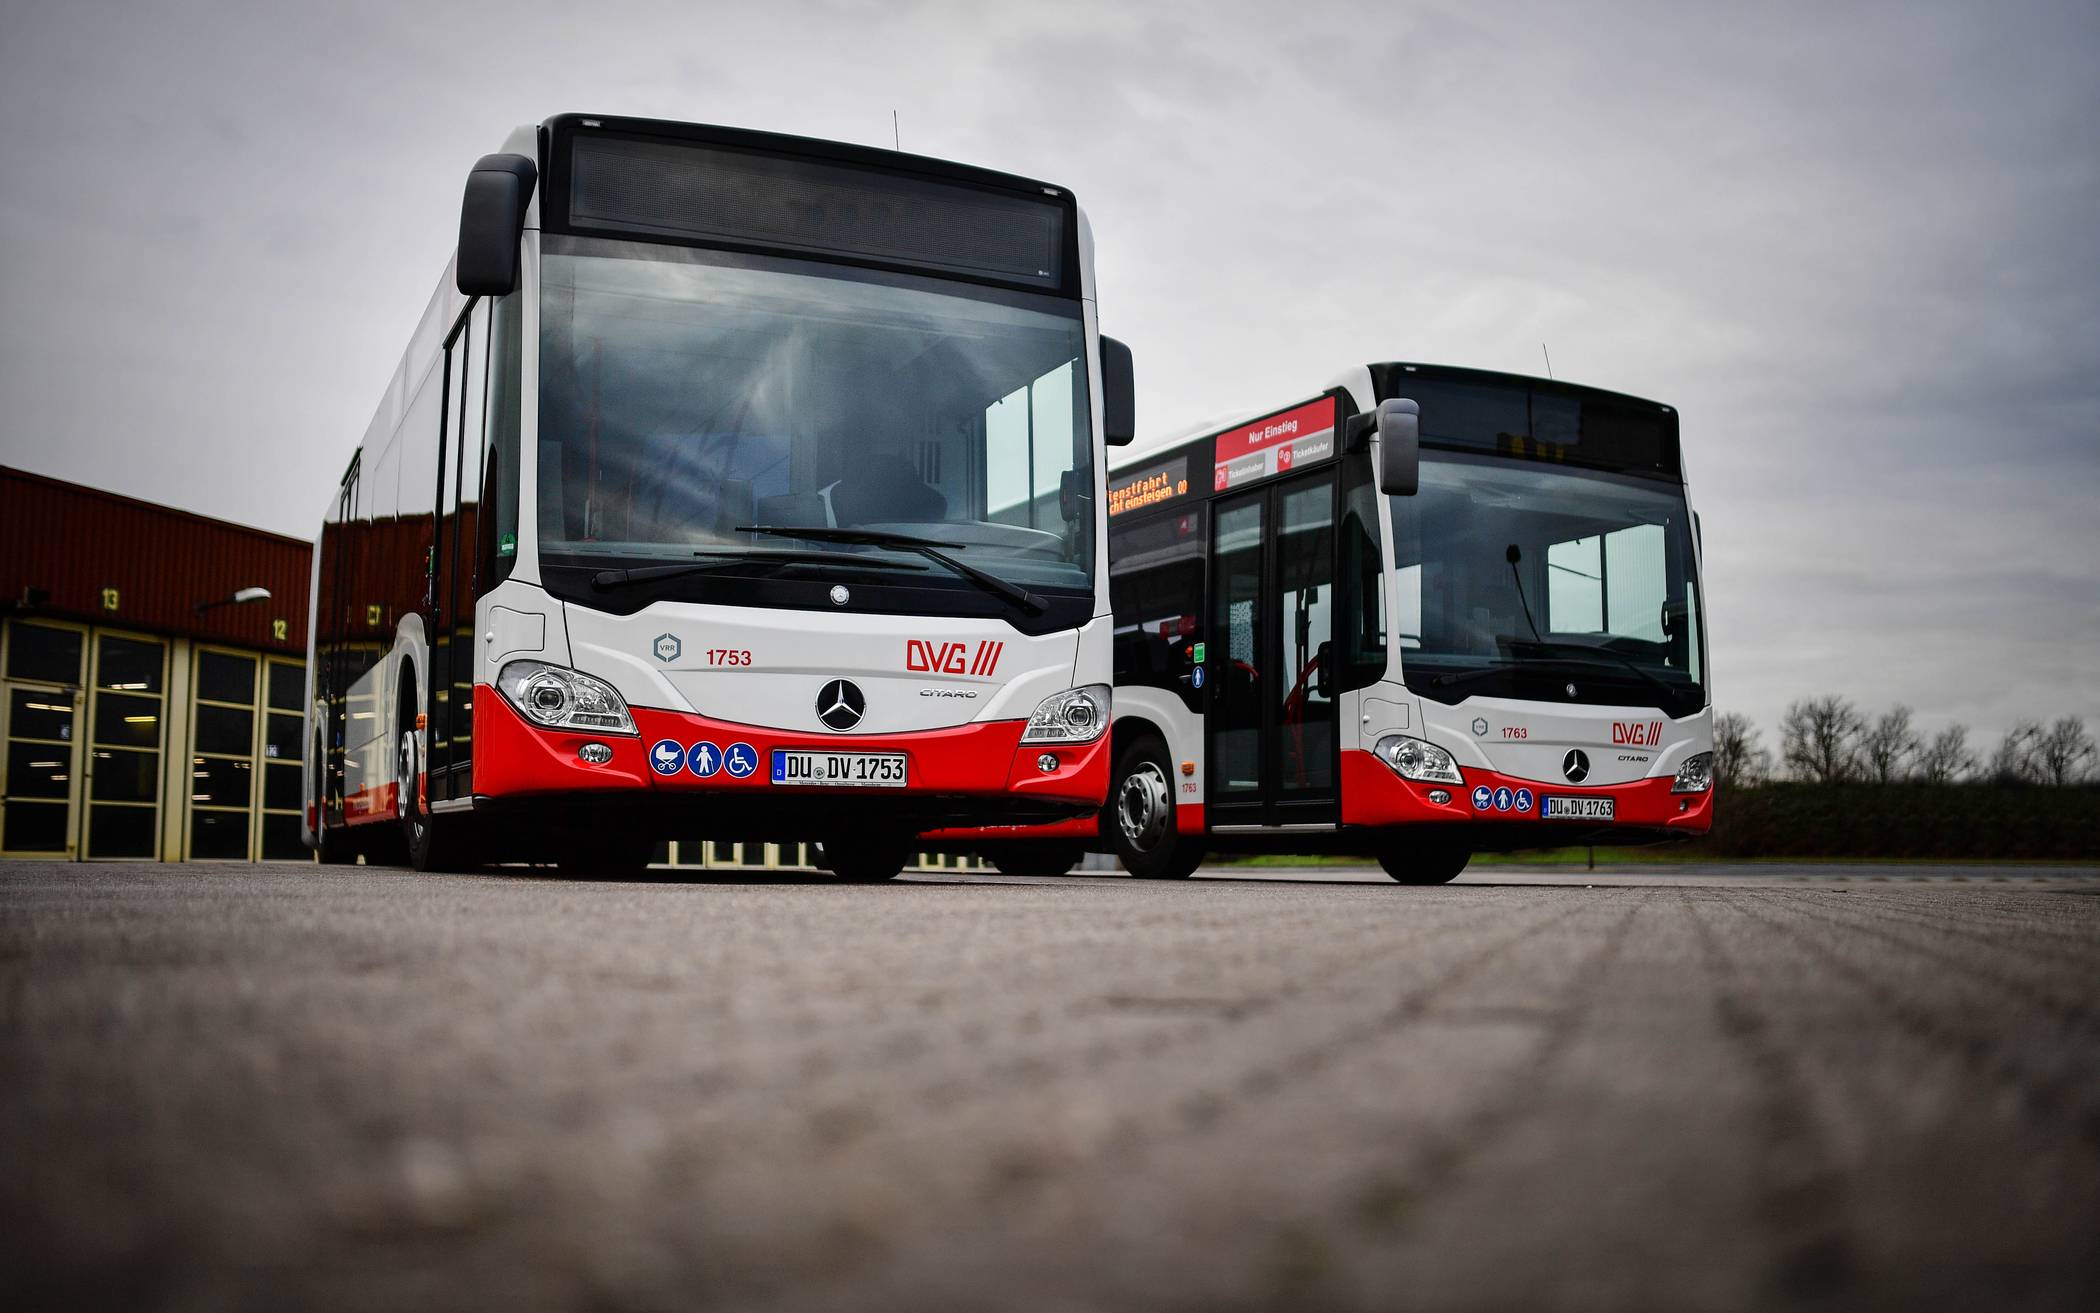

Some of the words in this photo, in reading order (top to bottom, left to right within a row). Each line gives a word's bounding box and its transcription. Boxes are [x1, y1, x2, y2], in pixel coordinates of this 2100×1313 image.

[1248, 430, 1263, 444] Nur
[1264, 419, 1298, 439] Einstieg
[1107, 471, 1168, 502] ienstfahrt
[102, 587, 118, 610] 13
[273, 619, 287, 641] 12
[706, 649, 752, 666] 1753
[920, 688, 978, 699] CITARO
[1502, 727, 1527, 739] 1763
[787, 756, 812, 778] DU
[856, 758, 904, 780] 1753
[1182, 783, 1197, 793] 1763
[1550, 799, 1563, 815] DU
[1586, 800, 1613, 816] 1763
